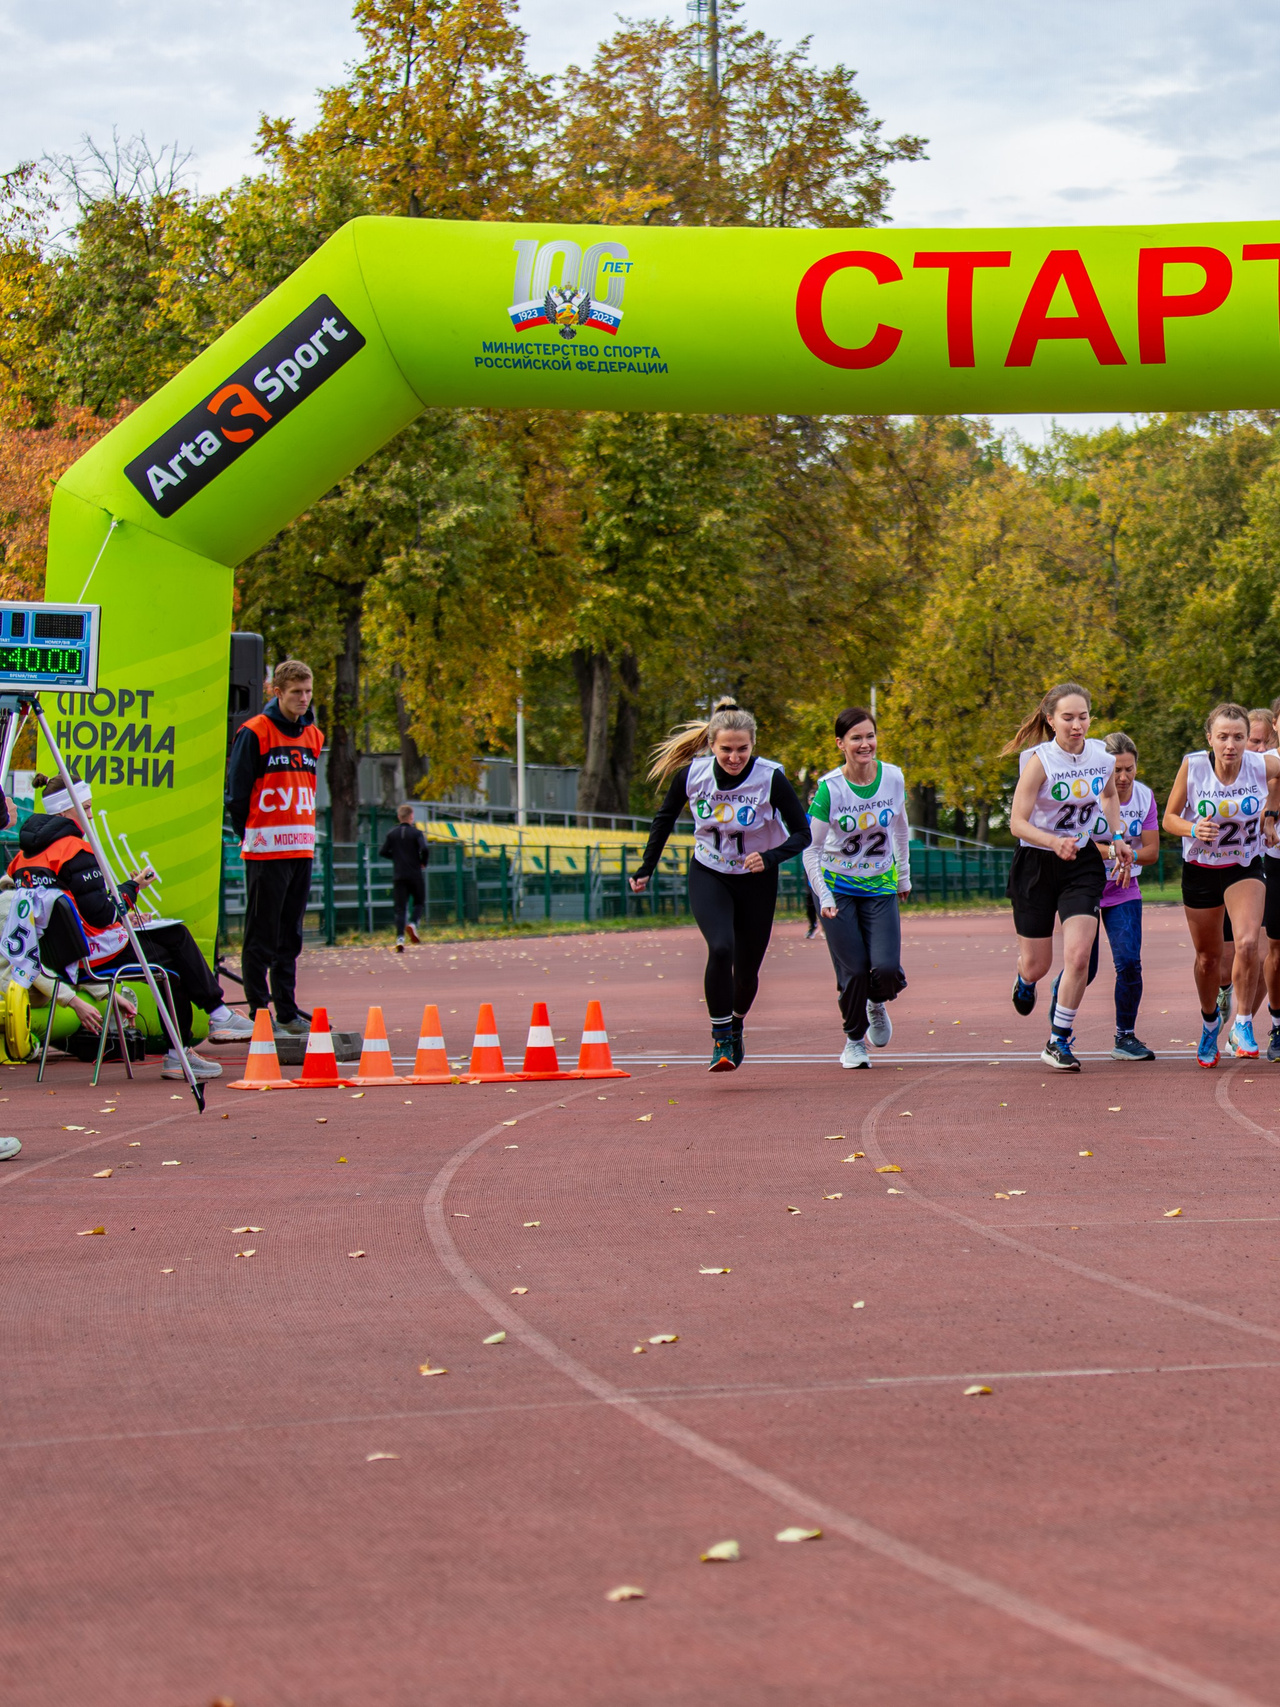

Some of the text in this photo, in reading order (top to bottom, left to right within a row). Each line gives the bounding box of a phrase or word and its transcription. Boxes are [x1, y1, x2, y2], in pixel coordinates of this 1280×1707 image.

[602, 261, 634, 274] ЛЕТ
[518, 309, 539, 322] 1923
[591, 310, 615, 326] 2023
[482, 341, 661, 359] МИНИСТЕРСТВО СПОРТА
[474, 355, 669, 375] РОССИЙСКОЙ ФЕДЕРАЦИИ
[146, 316, 349, 501] Arta Sport
[0, 647, 80, 674] :40.00
[56, 720, 175, 755] НОРМА
[268, 754, 290, 767] Arta
[1052, 766, 1107, 781] VMARAFONE
[696, 790, 759, 805] VMARAFONE
[1197, 784, 1259, 799] VMARAFONE
[838, 797, 894, 814] VMARAFONE
[703, 826, 746, 856] 11
[1204, 816, 1260, 849] 22
[840, 831, 888, 858] 32
